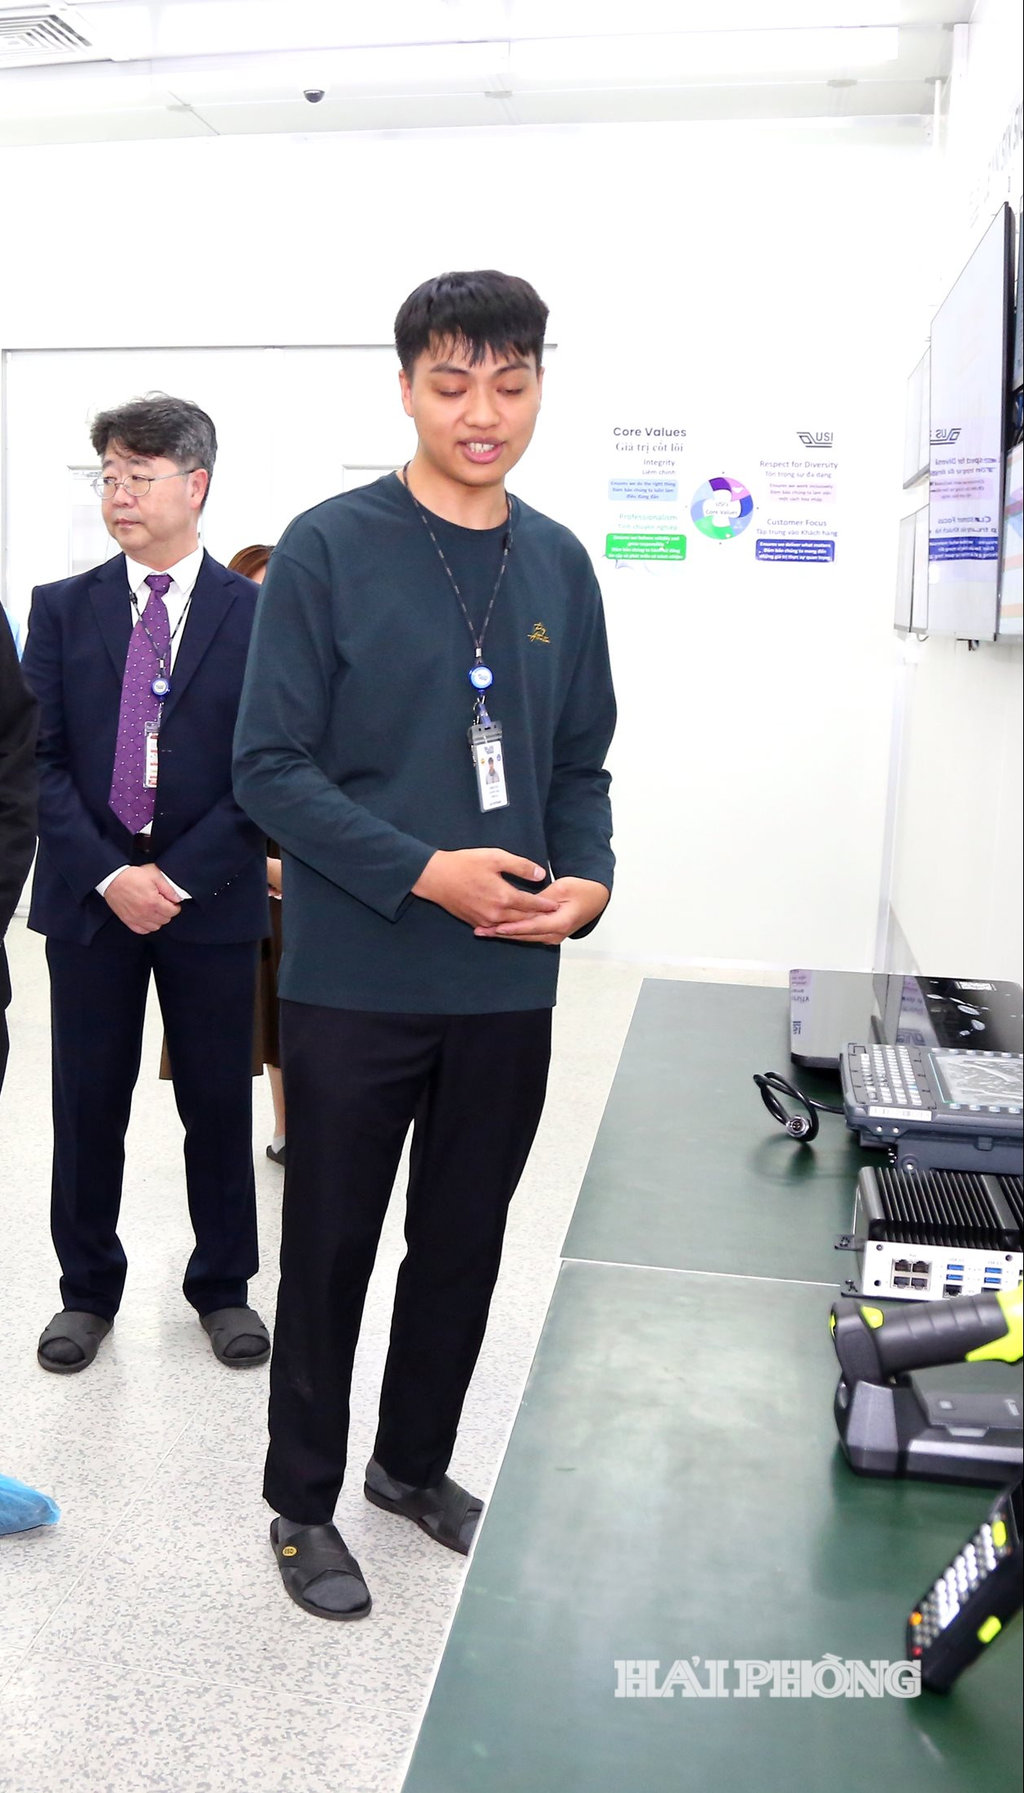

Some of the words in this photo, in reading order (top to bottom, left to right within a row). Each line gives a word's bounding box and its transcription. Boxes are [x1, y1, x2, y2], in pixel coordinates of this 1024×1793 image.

[613, 427, 642, 437] Core
[645, 427, 687, 437] Values
[815, 432, 834, 442] USI
[643, 459, 676, 467] Integrity
[759, 460, 789, 468] Respect
[804, 461, 839, 470] Diversity
[766, 518, 804, 526] Customer
[805, 519, 828, 527] Focus
